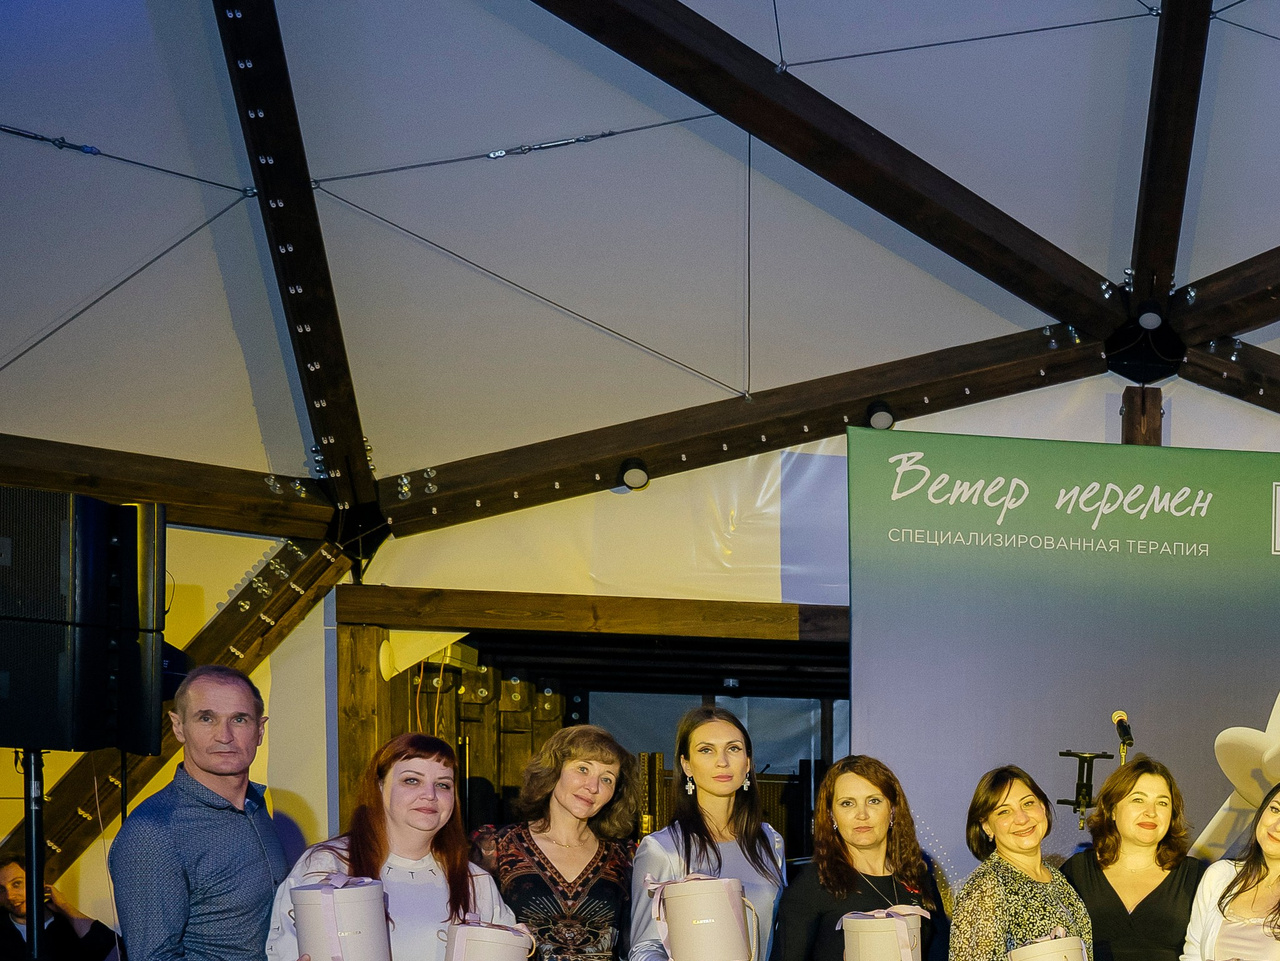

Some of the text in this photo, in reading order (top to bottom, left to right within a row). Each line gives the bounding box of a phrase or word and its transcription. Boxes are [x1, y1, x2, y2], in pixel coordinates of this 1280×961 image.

[888, 452, 1213, 530] Ветер перемен
[888, 528, 1209, 557] СПЕЦИАЛИЗИРОВАННАЯ ТЕРАПИЯ
